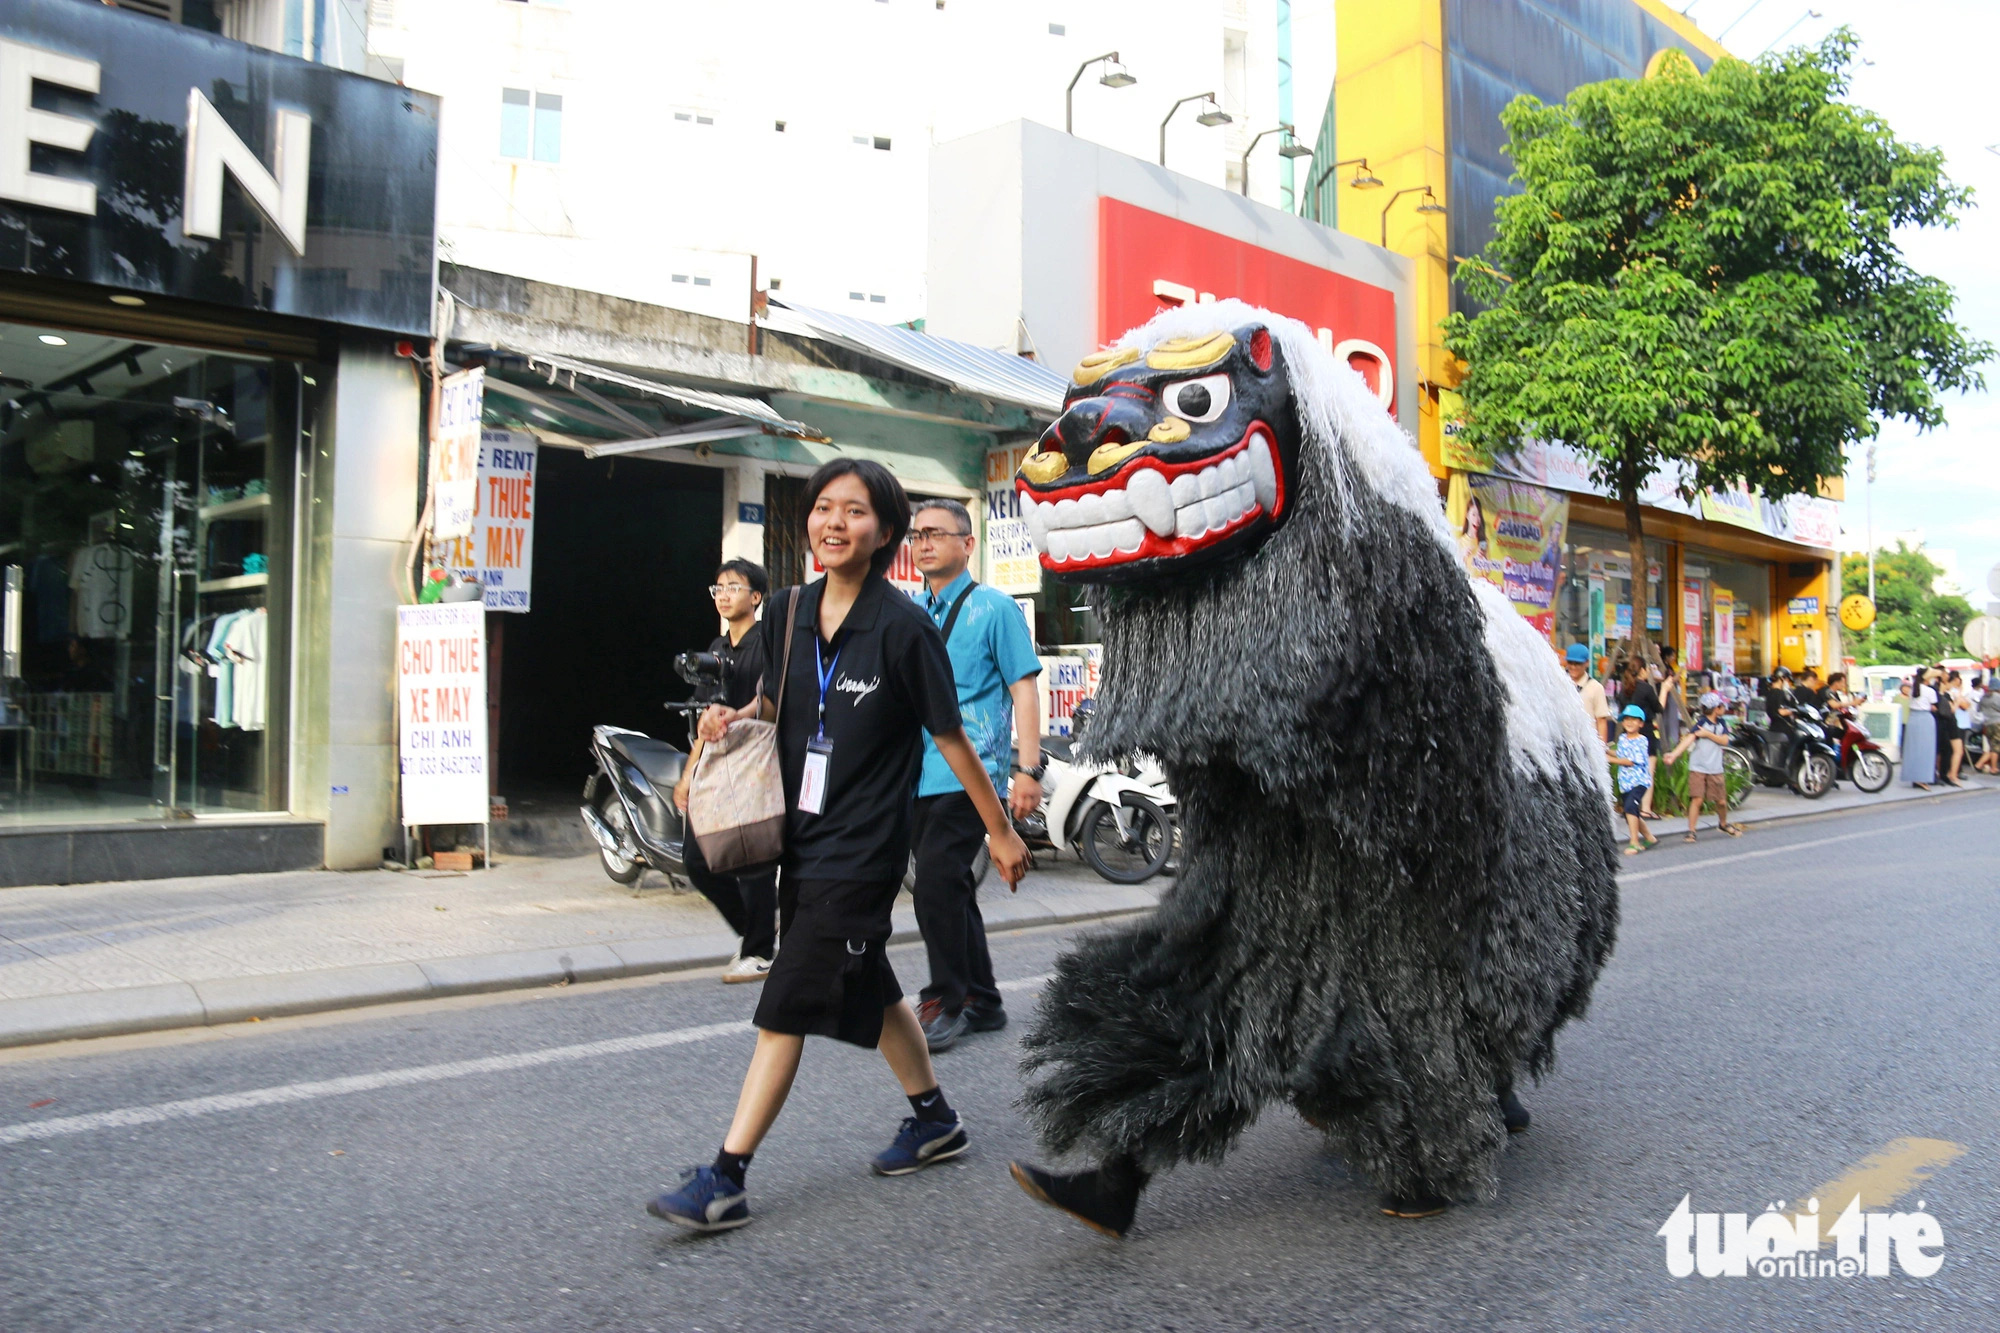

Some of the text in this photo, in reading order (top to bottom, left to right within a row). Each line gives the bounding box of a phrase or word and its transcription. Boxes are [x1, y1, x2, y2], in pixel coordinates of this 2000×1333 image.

[492, 447, 535, 471] RENT
[987, 450, 1009, 483] CHO
[488, 471, 533, 520] THUÊ
[451, 519, 526, 569] XE MÁY
[402, 629, 480, 675] CHO THUÊ
[1058, 664, 1084, 684] RENT
[410, 678, 471, 723] XE MÁY
[441, 729, 472, 748] ANH
